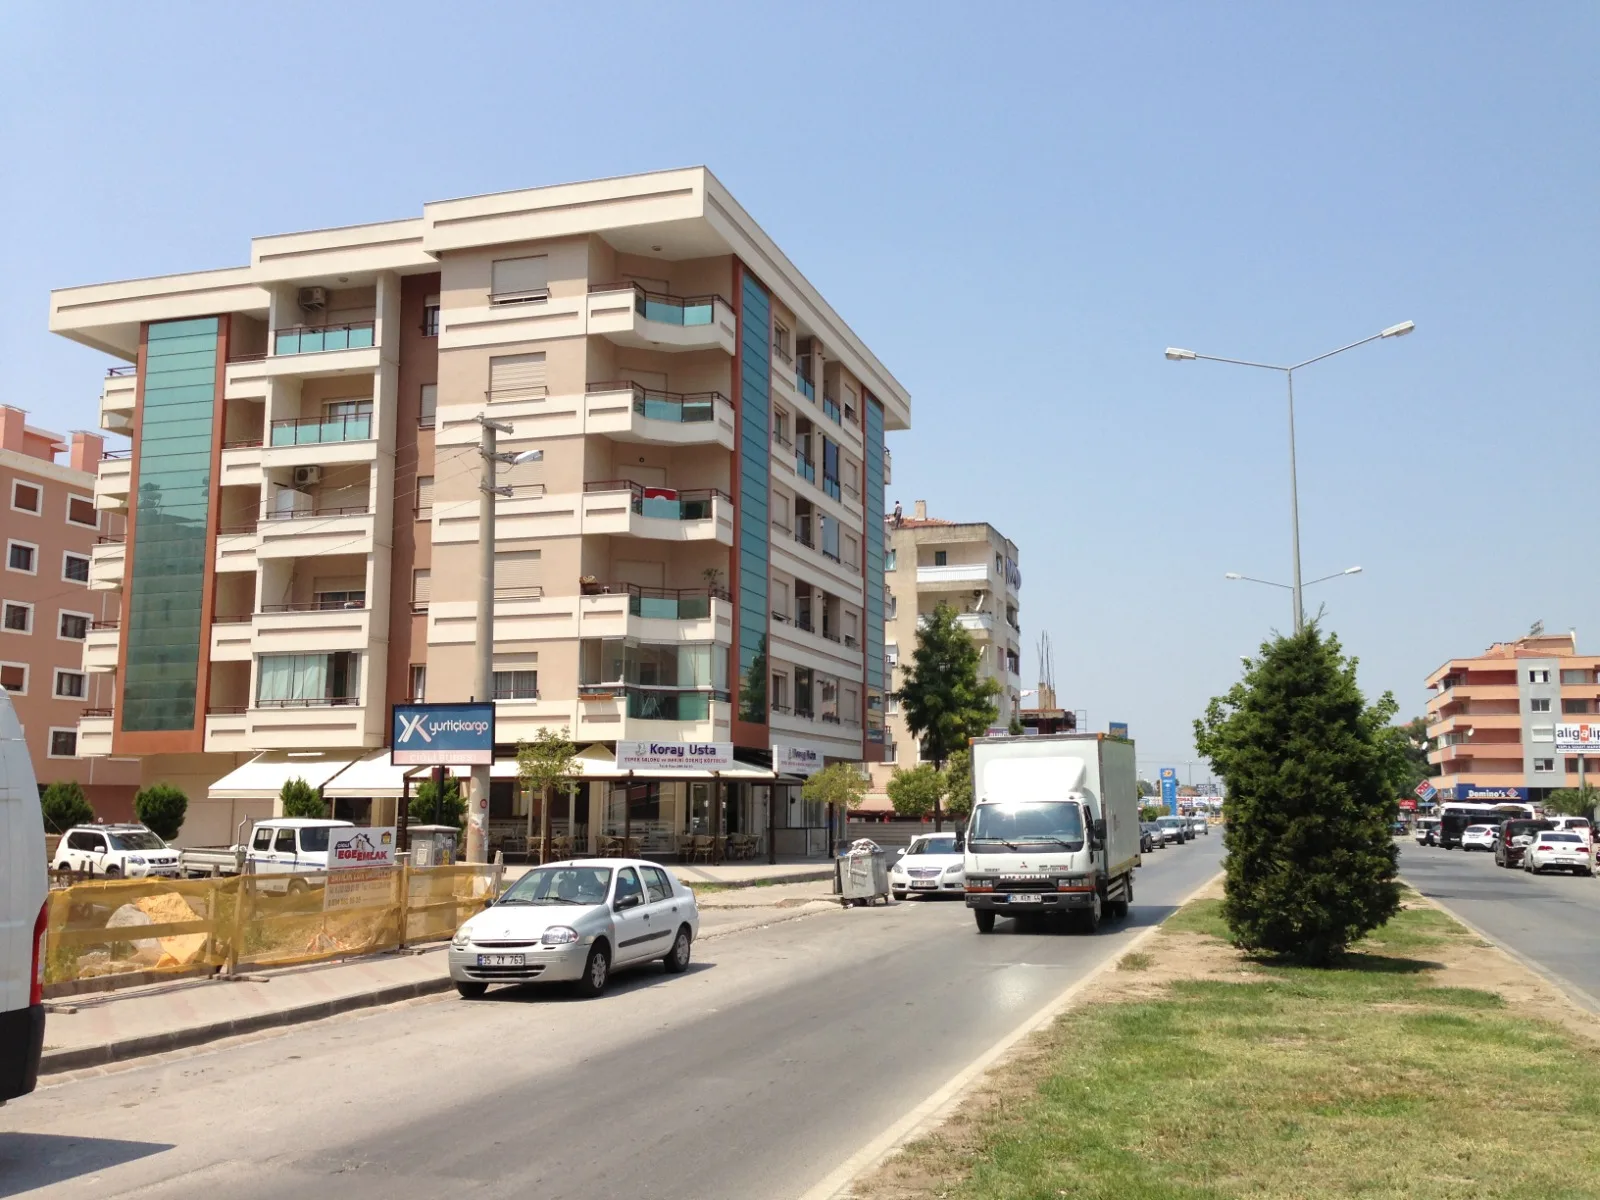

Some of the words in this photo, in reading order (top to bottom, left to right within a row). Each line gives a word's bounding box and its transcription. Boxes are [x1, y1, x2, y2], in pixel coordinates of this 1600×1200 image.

[650, 743, 684, 757] Koray
[689, 744, 717, 756] Usta
[1468, 789, 1506, 798] Domino's
[483, 955, 492, 965] 35
[496, 955, 506, 965] ZY
[509, 955, 523, 965] 763
